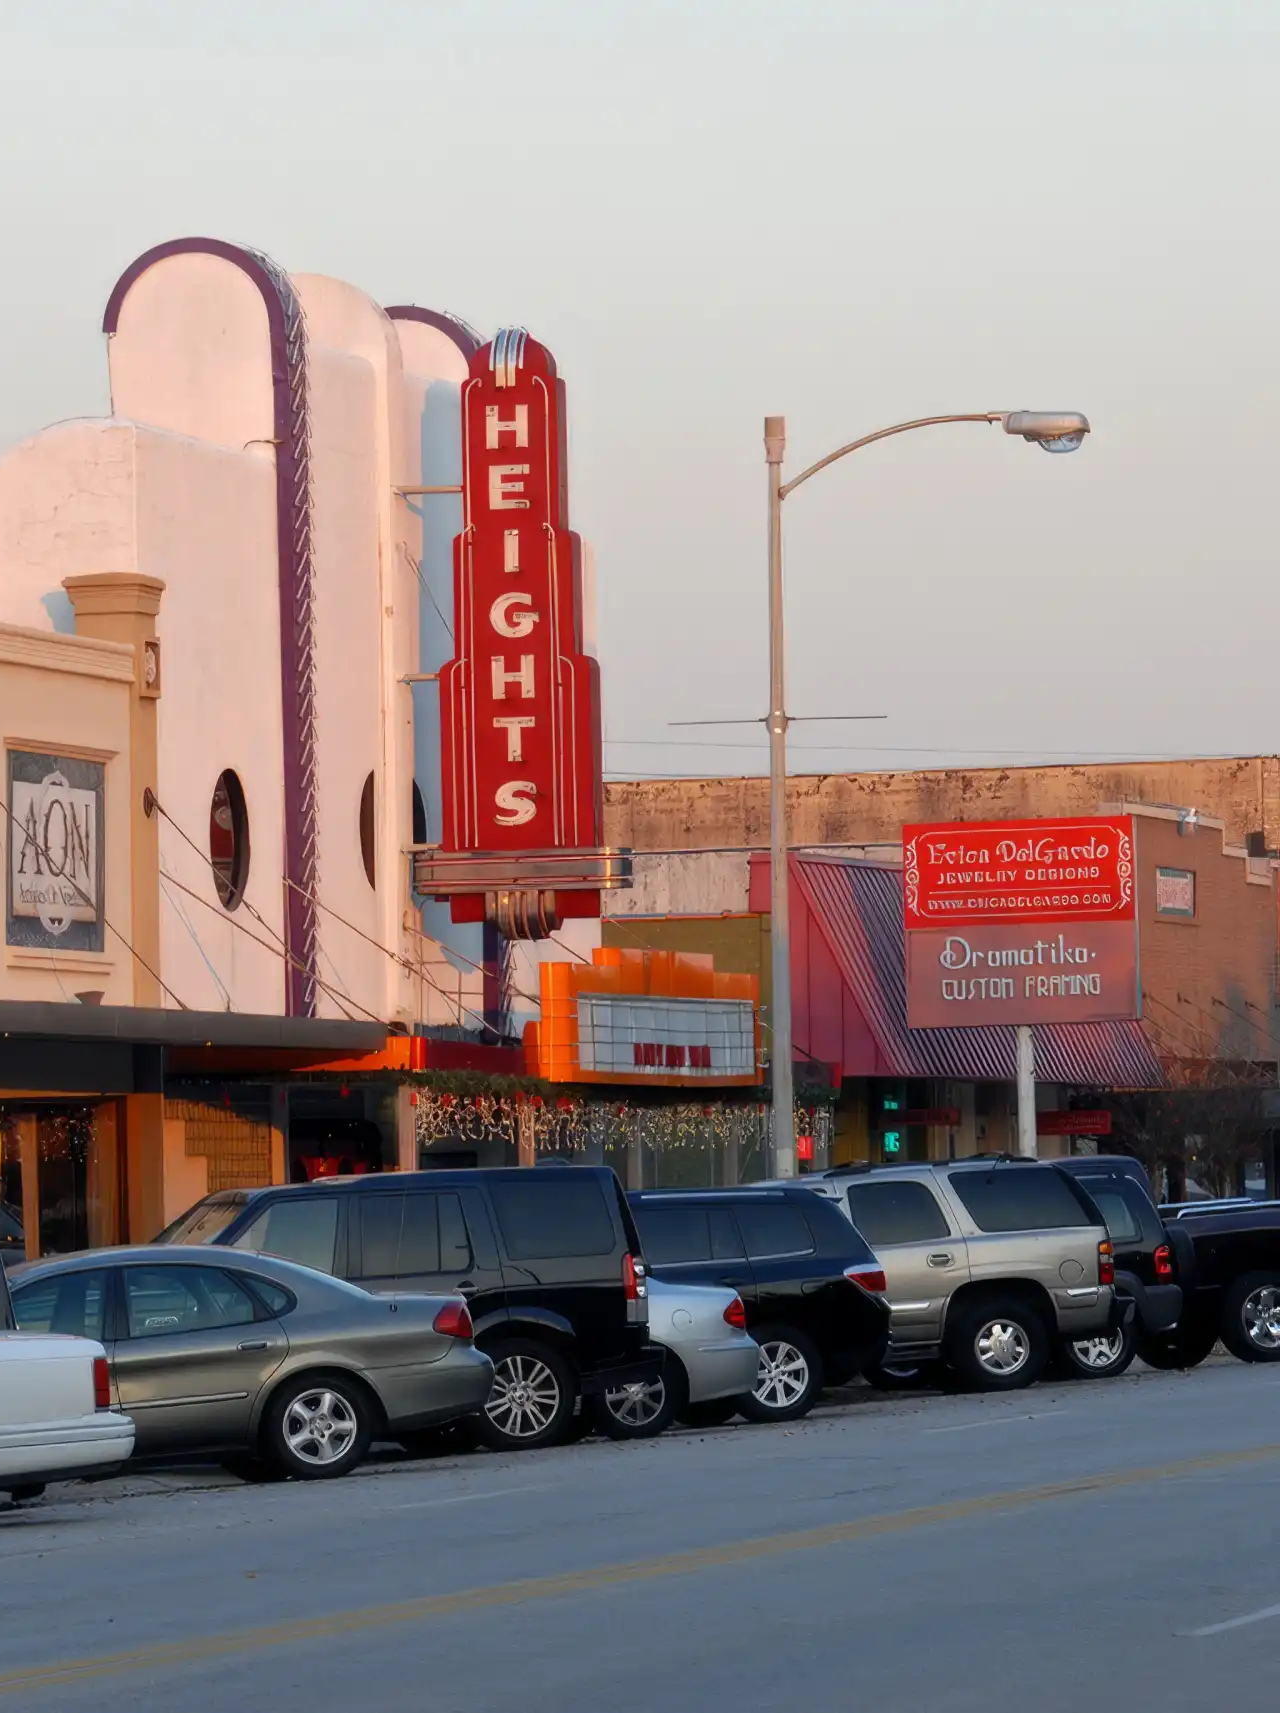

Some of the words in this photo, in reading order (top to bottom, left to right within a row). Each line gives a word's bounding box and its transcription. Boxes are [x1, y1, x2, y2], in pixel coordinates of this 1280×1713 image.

[484, 403, 540, 827] HEIGHTS
[937, 869, 1018, 885] JEWELRY
[1024, 866, 1100, 881] DESIGNS
[941, 977, 1015, 1000] CUSTOM
[1024, 973, 1102, 998] FRAMING
